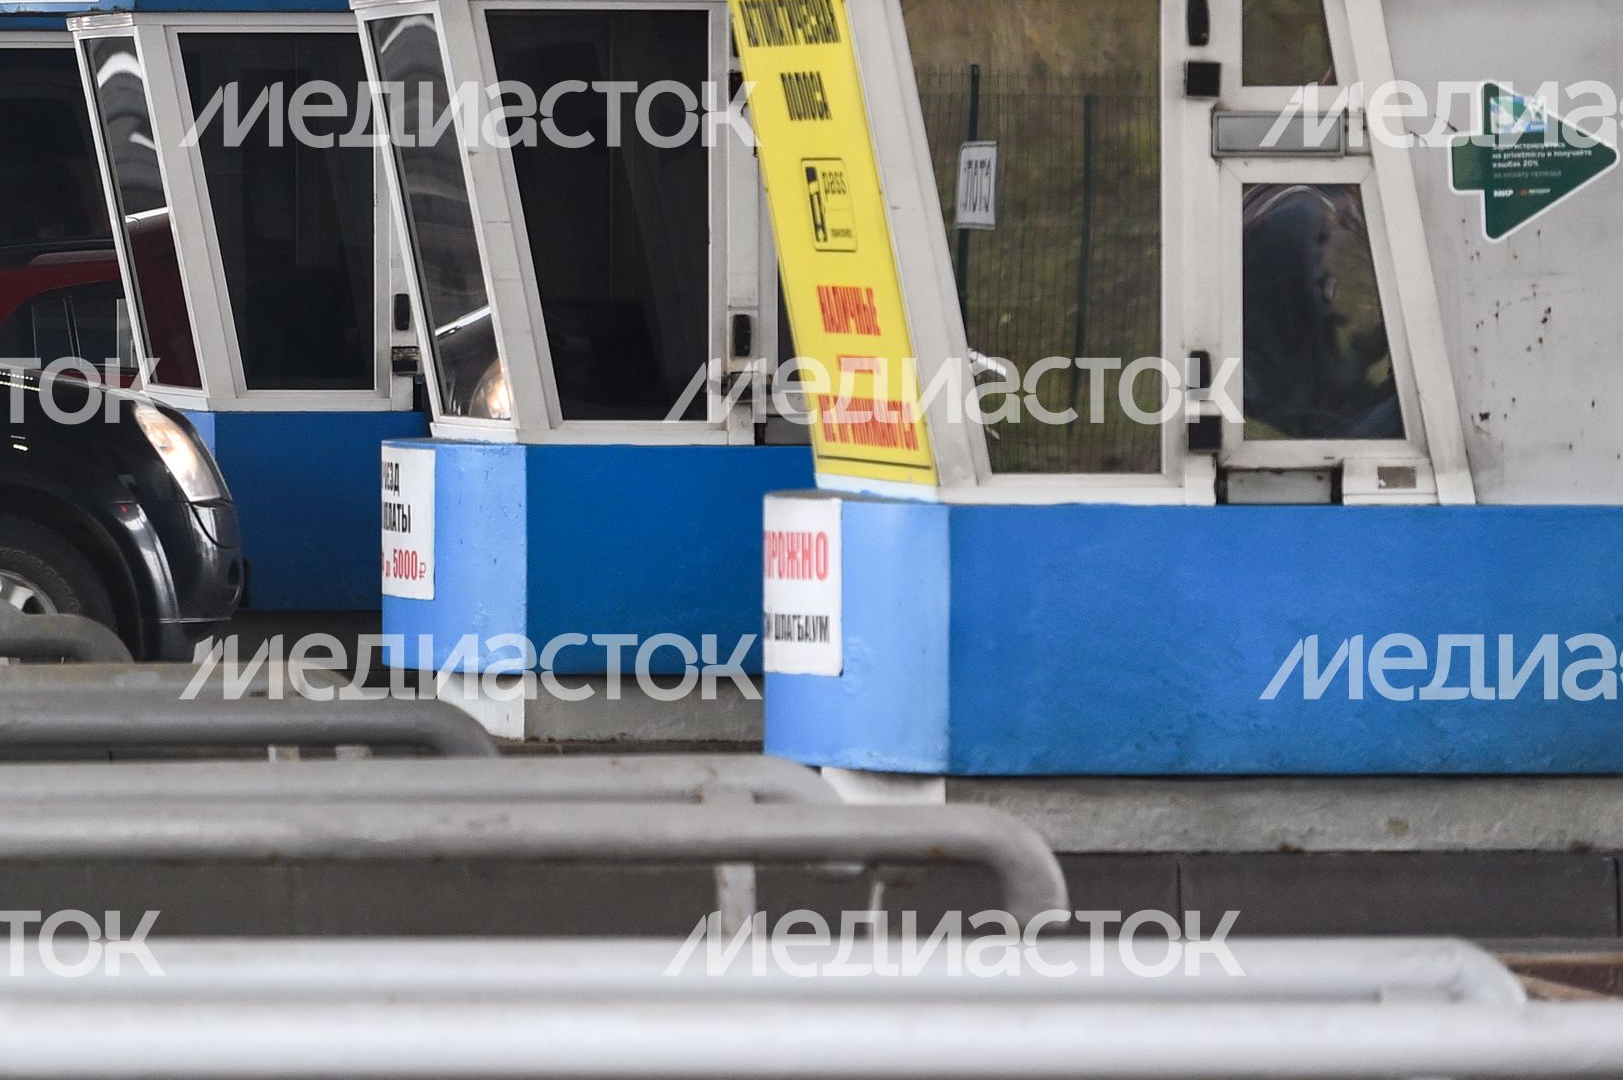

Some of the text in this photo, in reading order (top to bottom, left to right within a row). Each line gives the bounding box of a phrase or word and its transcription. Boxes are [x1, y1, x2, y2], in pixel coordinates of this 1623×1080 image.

[780, 71, 832, 121] ПОЛОСА
[1493, 190, 1514, 198] МИР
[774, 613, 830, 644] ШЛАГБАУМ
